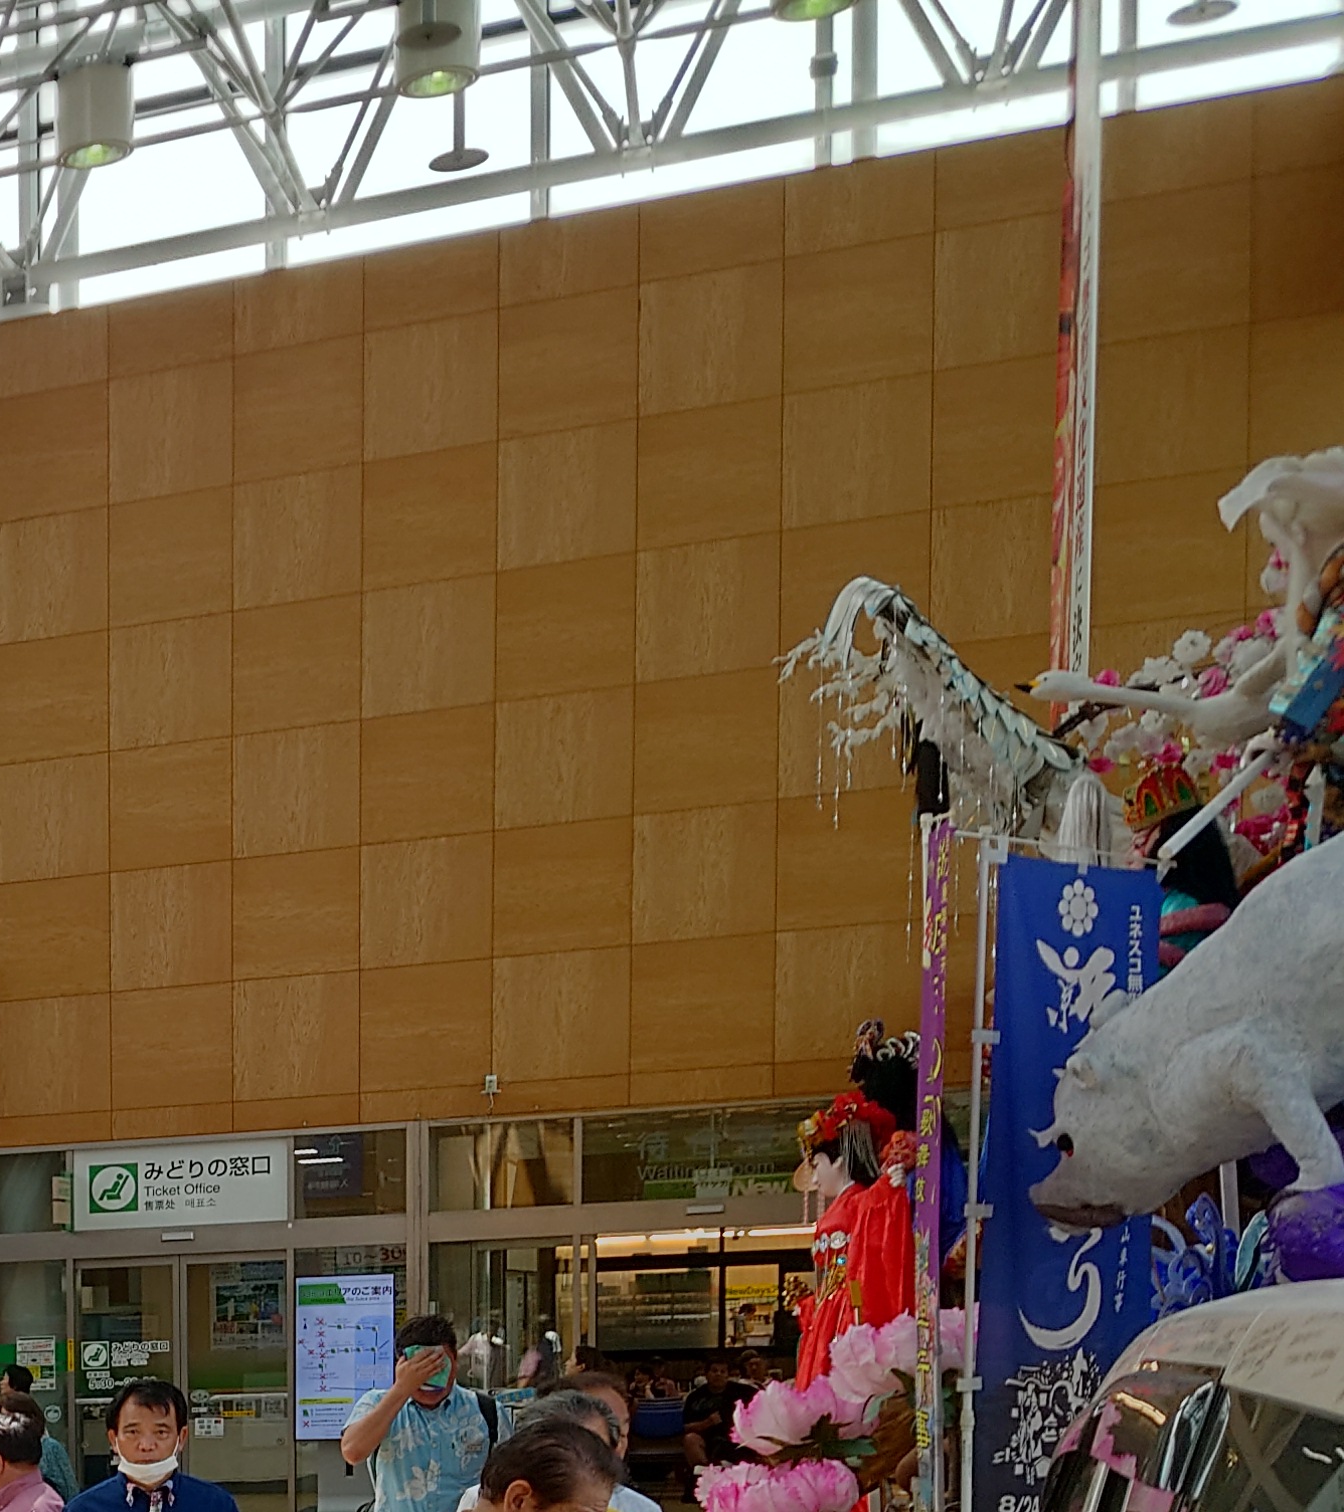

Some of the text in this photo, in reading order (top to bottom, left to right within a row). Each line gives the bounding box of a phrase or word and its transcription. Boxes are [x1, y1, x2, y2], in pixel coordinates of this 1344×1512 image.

[144, 1155, 271, 1181] みどりの窓口
[144, 1182, 221, 1197] Ticket Office
